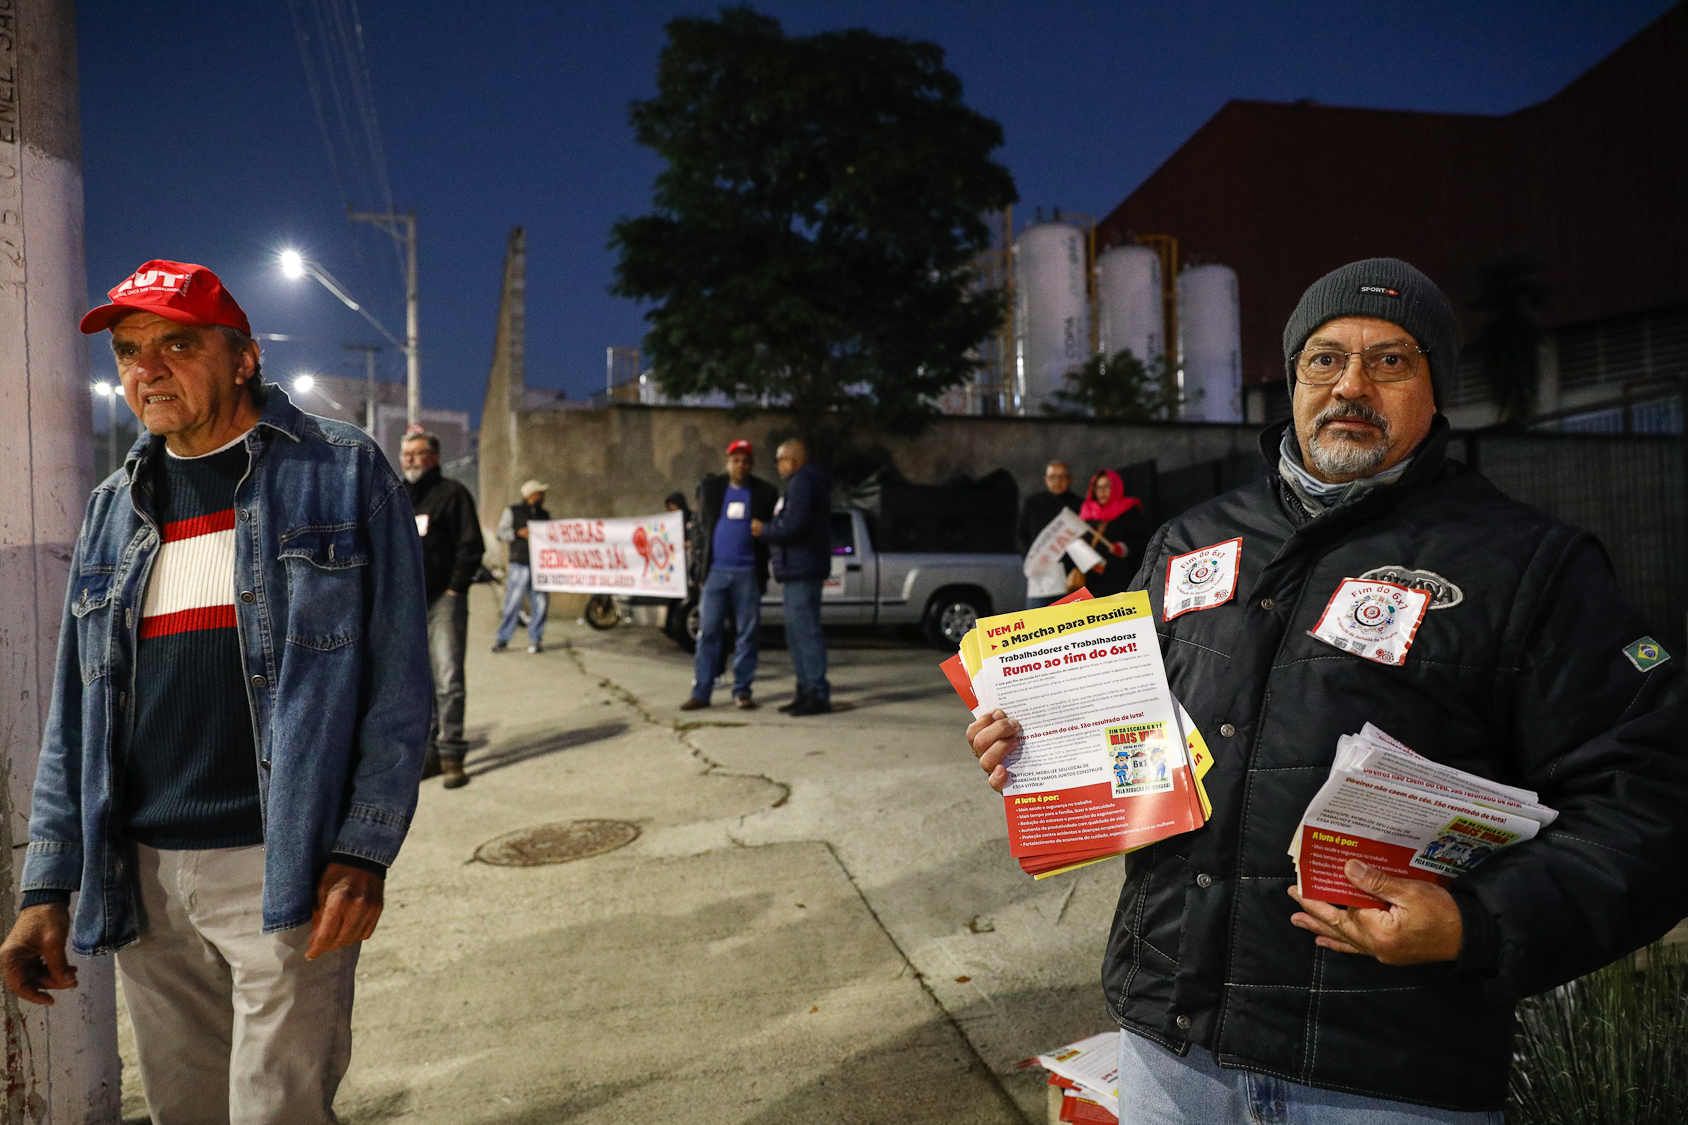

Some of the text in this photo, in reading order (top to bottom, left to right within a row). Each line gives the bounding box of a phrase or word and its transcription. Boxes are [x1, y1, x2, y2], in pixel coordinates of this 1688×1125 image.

[1181, 557, 1196, 569] Fim
[1212, 549, 1226, 558] 6x1
[1351, 585, 1408, 610] Fim do 6x1
[987, 619, 1025, 638] VEM AÍ
[1002, 606, 1137, 647] a Marcha para Brasília:
[999, 644, 1062, 663] Trabalhadores
[1070, 632, 1137, 649] Trabalhadoras
[1003, 642, 1137, 676] Rumo ao fim do 6x1!
[1092, 717, 1120, 726] resultado
[1110, 732, 1137, 746] MAIS
[1345, 777, 1374, 788] Direitos
[1447, 804, 1480, 817] resultado
[1490, 816, 1507, 824] luta!
[1319, 832, 1334, 843] luta
[1341, 839, 1358, 847] por:
